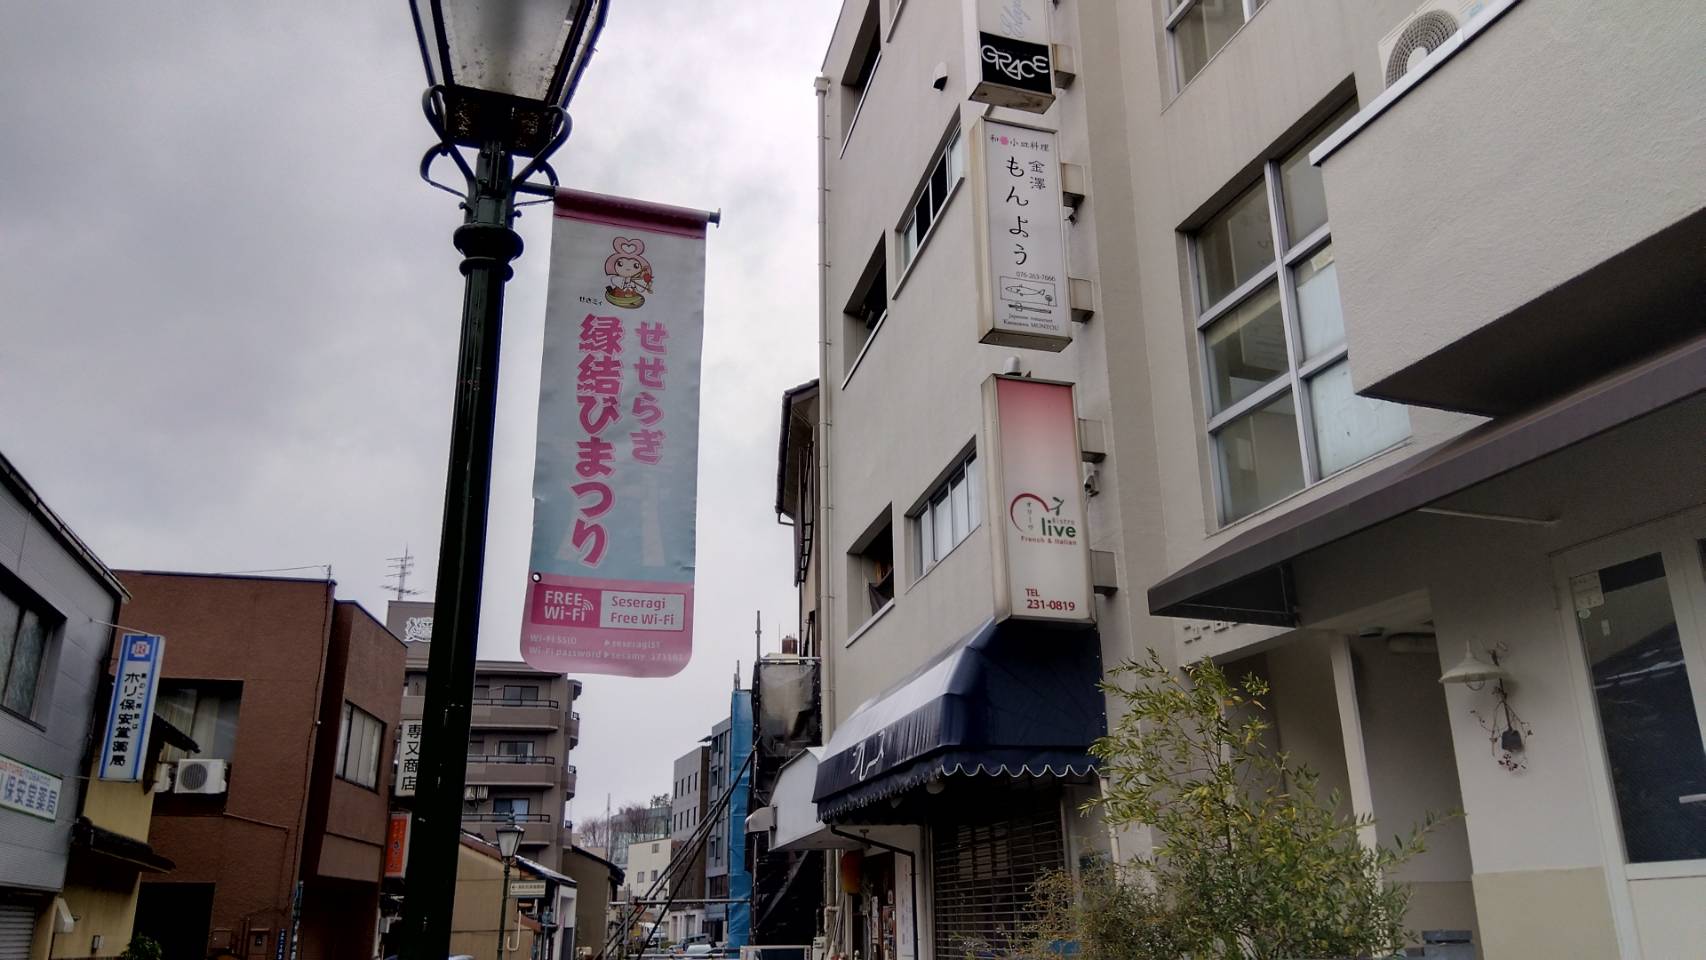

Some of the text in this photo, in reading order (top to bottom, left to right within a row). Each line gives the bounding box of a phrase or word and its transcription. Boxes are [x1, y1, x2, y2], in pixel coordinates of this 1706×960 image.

[981, 45, 1049, 80] GRACE
[1005, 156, 1029, 266] もんよう
[630, 320, 669, 464] せせらぎ
[571, 313, 624, 567] 縁結びまつり
[544, 590, 583, 606] FREE
[1025, 588, 1040, 597] TEL
[611, 596, 666, 610] Seseragi
[1027, 599, 1076, 611] 231-0819
[544, 605, 585, 622] Wi-Fi
[610, 612, 675, 625] Free Wi-Fi
